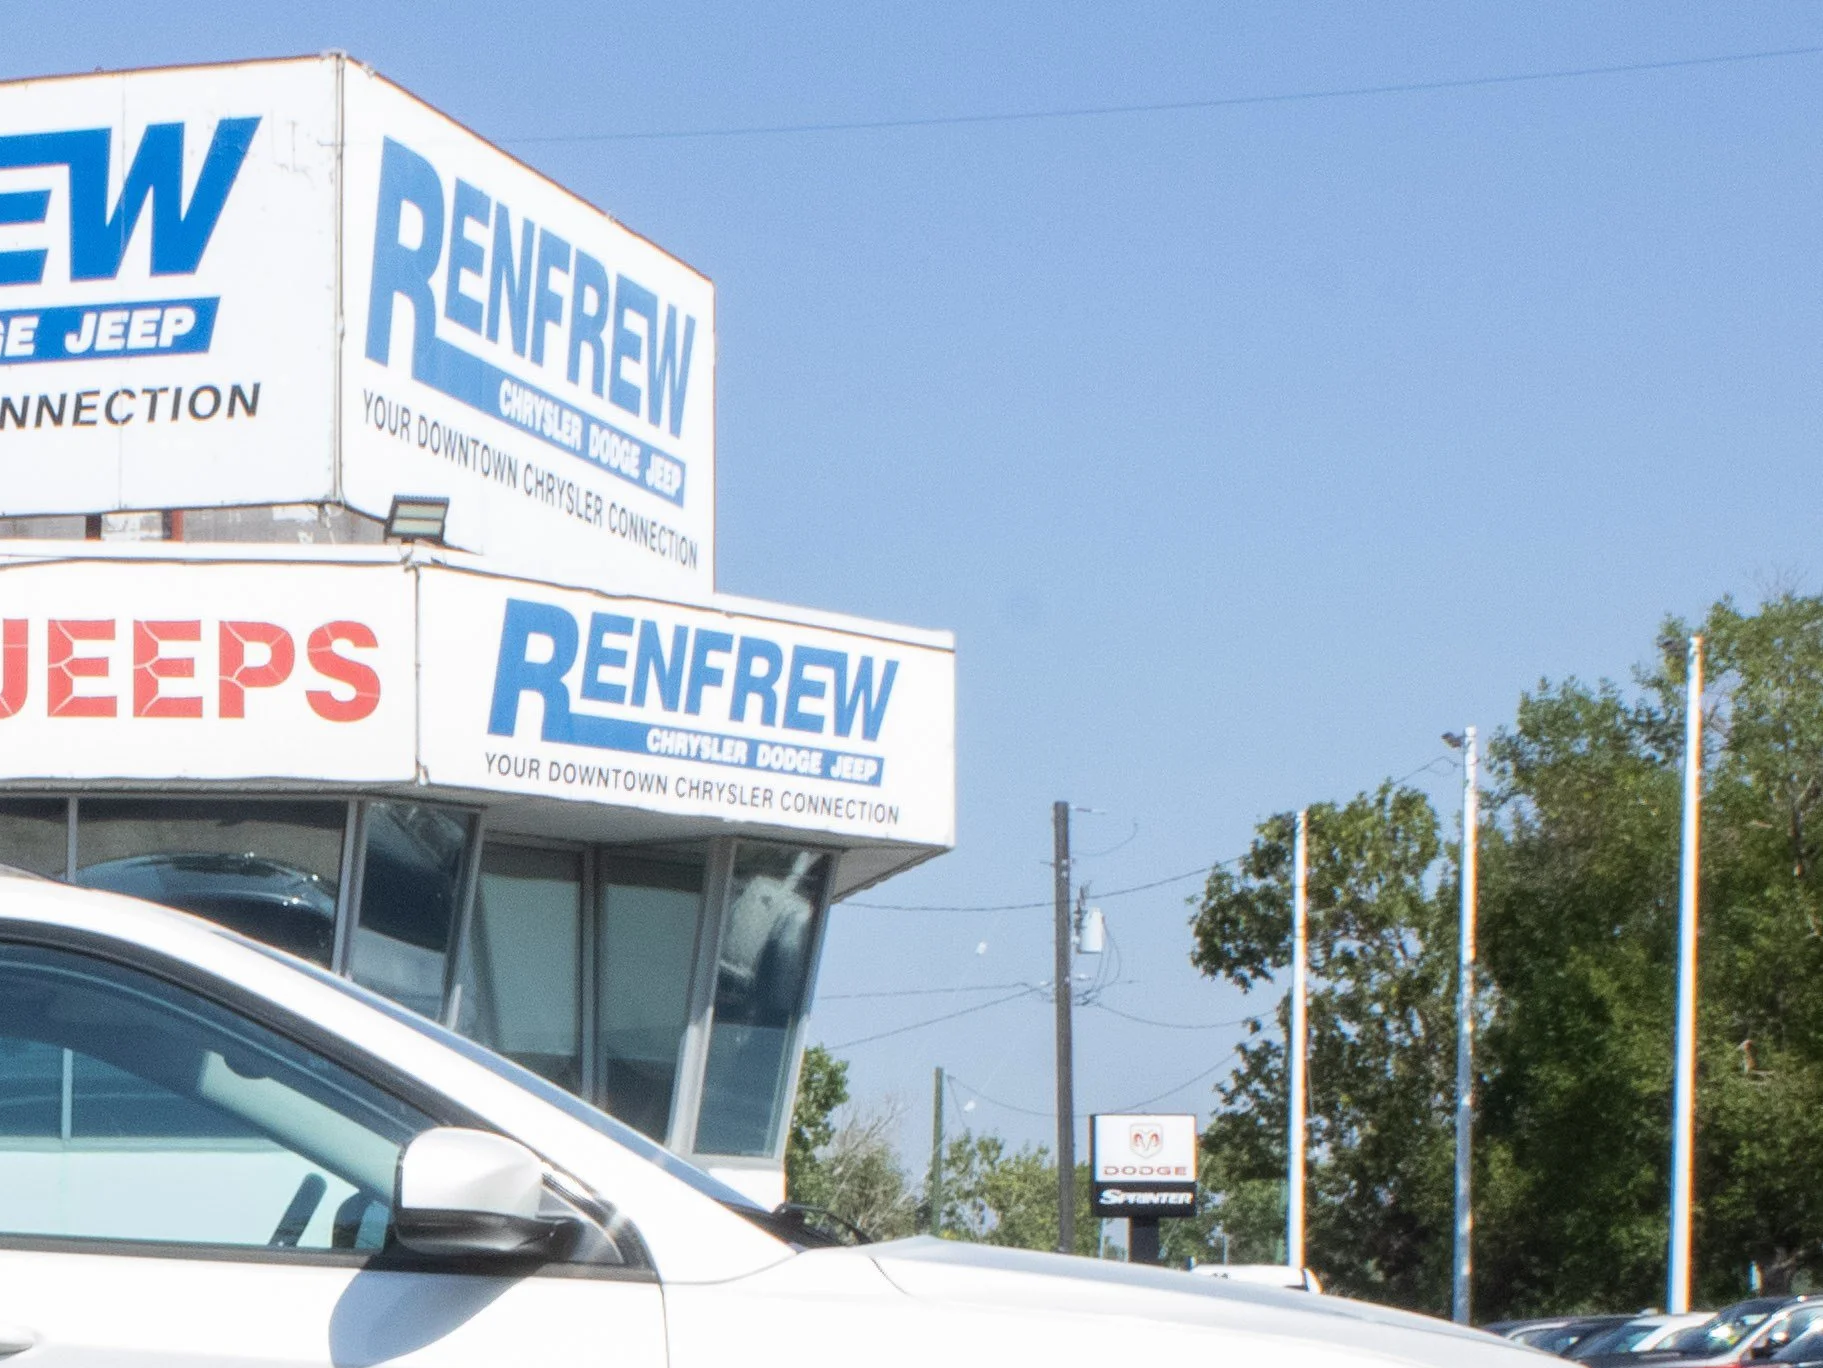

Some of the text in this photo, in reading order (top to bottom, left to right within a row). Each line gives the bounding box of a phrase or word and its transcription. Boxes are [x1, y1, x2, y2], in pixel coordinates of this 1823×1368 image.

[64, 305, 196, 355] JEEP
[364, 134, 697, 440] RENFREW
[363, 387, 698, 570] YOUR DOWNTOWN CHRYSLER CONNECTION
[499, 379, 685, 497] CHRYSLER DODGE JEEP
[486, 597, 900, 743] RENFREW
[484, 751, 900, 826] YOUR DOWNTOWN CHRYSLER CONNECTION
[646, 727, 878, 782] CHRYSLER DODGE JEEP
[1103, 1165, 1188, 1176] DODGE
